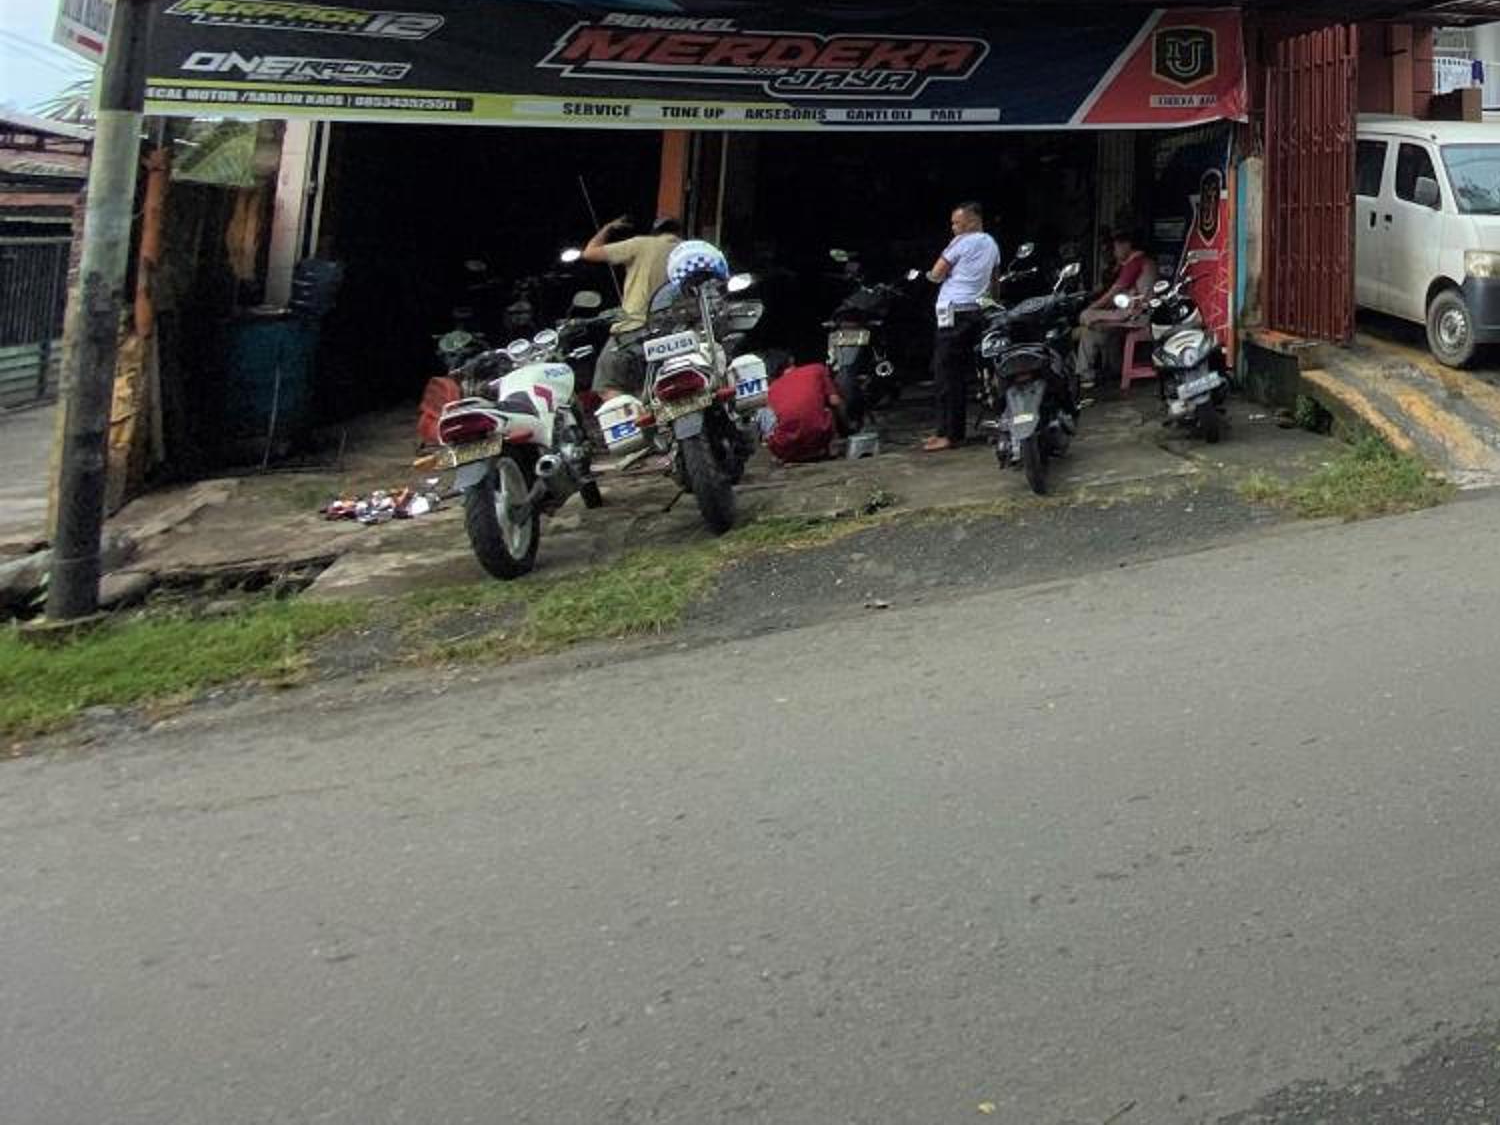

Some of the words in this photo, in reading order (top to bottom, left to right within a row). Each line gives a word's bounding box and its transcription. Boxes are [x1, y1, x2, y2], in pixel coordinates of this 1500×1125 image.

[602, 12, 736, 30] BENGKEL
[563, 28, 974, 70] MERDEKA
[180, 51, 299, 76] ONE
[297, 60, 412, 78] RACING
[774, 70, 917, 91] JAYA
[145, 86, 183, 99] ECAL
[562, 102, 633, 118] SERVICE
[661, 106, 699, 118] TUNE
[703, 107, 725, 119] UP
[744, 108, 828, 121] AKSESORIS
[930, 109, 963, 121] PART
[647, 338, 693, 356] POLISI
